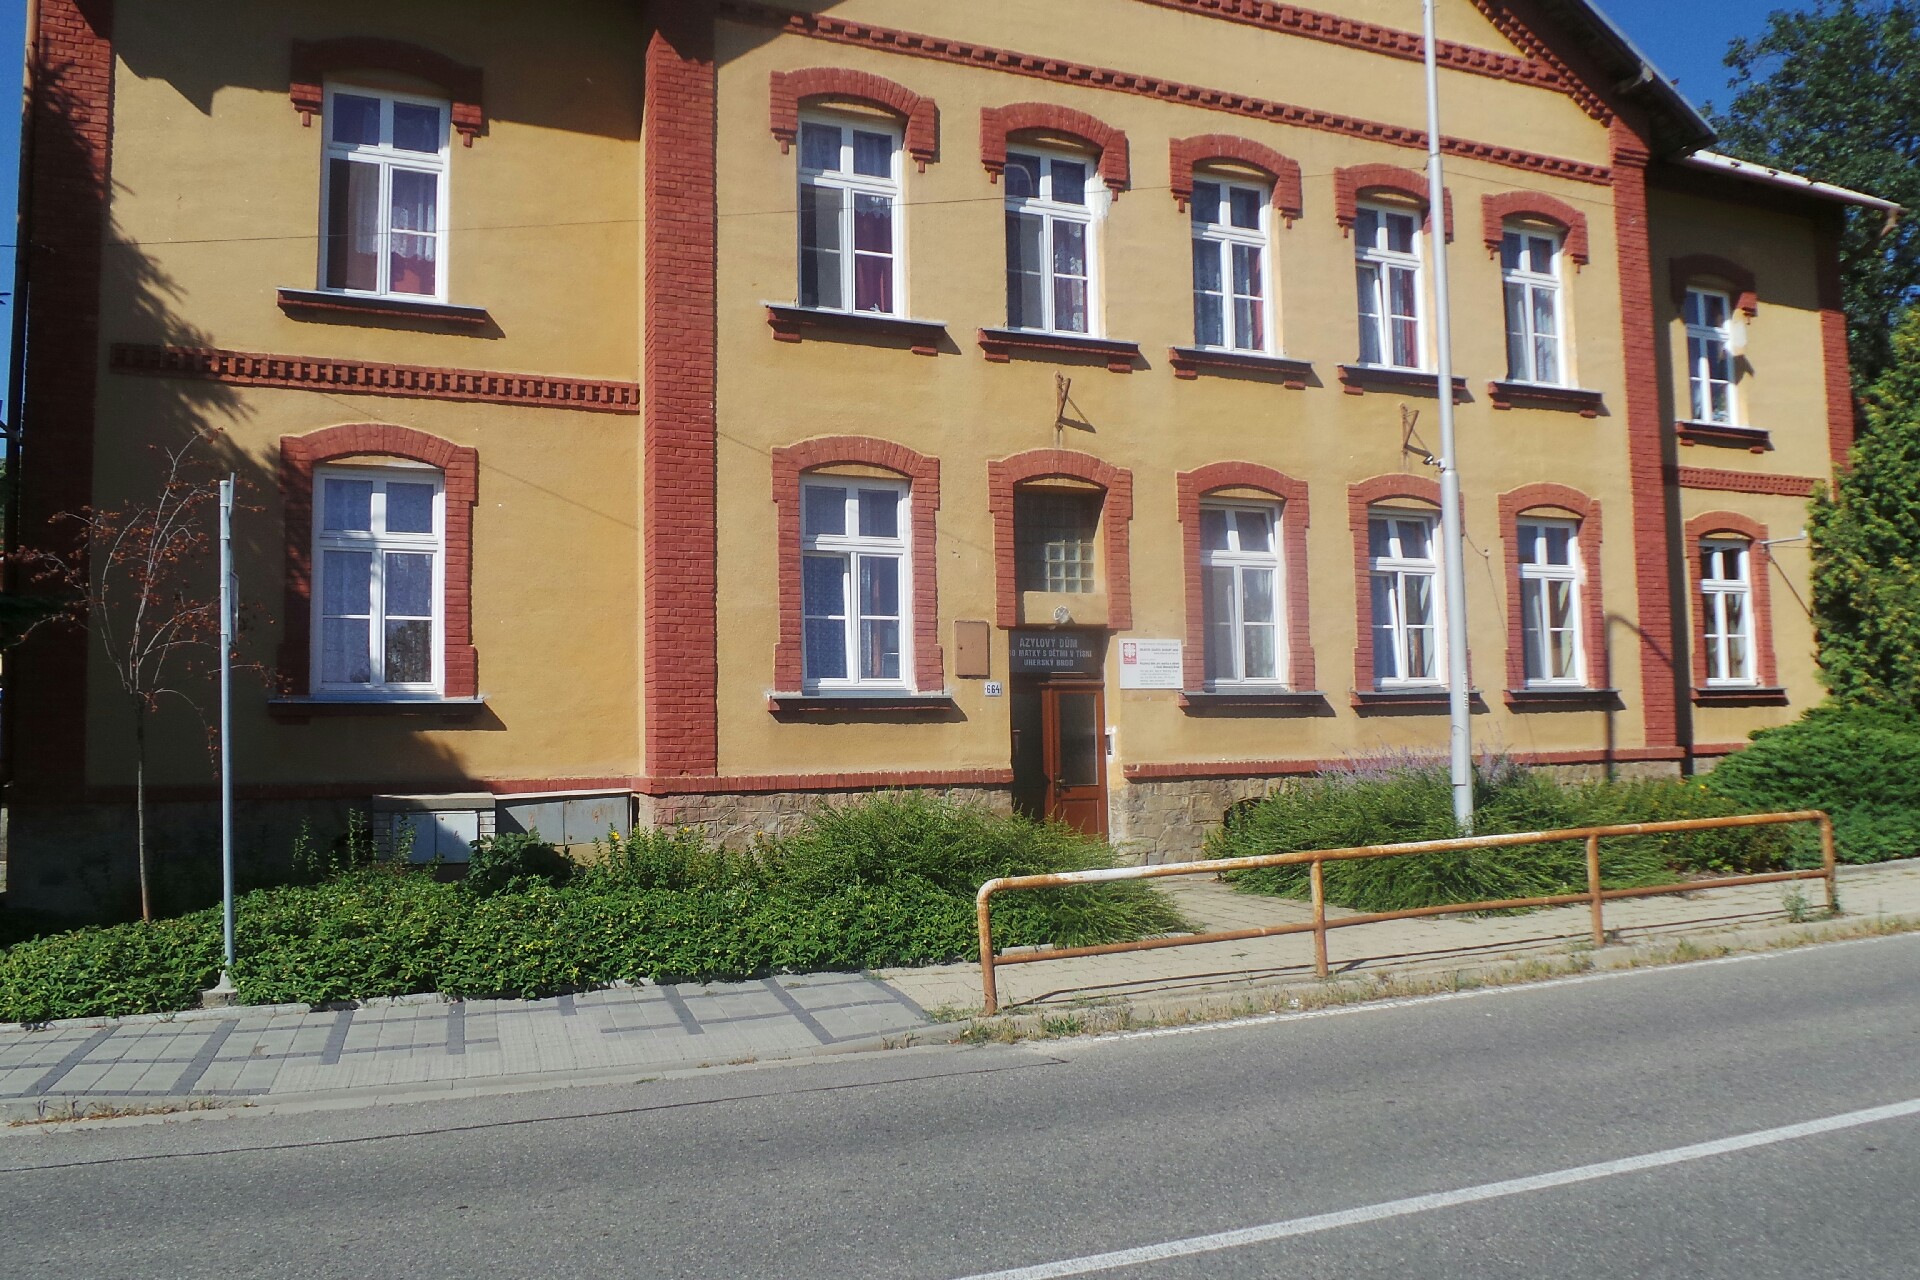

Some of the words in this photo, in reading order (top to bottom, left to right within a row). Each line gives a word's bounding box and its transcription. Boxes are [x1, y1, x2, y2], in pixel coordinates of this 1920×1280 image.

[1019, 637, 1056, 648] AZYLOVÝ
[1059, 636, 1078, 648] DŮM
[1019, 649, 1041, 657] MATKY
[1042, 649, 1047, 657] S
[1048, 648, 1068, 657] DĚTMI
[1076, 649, 1092, 658] TÍSNI
[1023, 658, 1054, 666] UHERSKÝ
[1056, 659, 1074, 667] BROD
[986, 684, 1000, 694] 664
